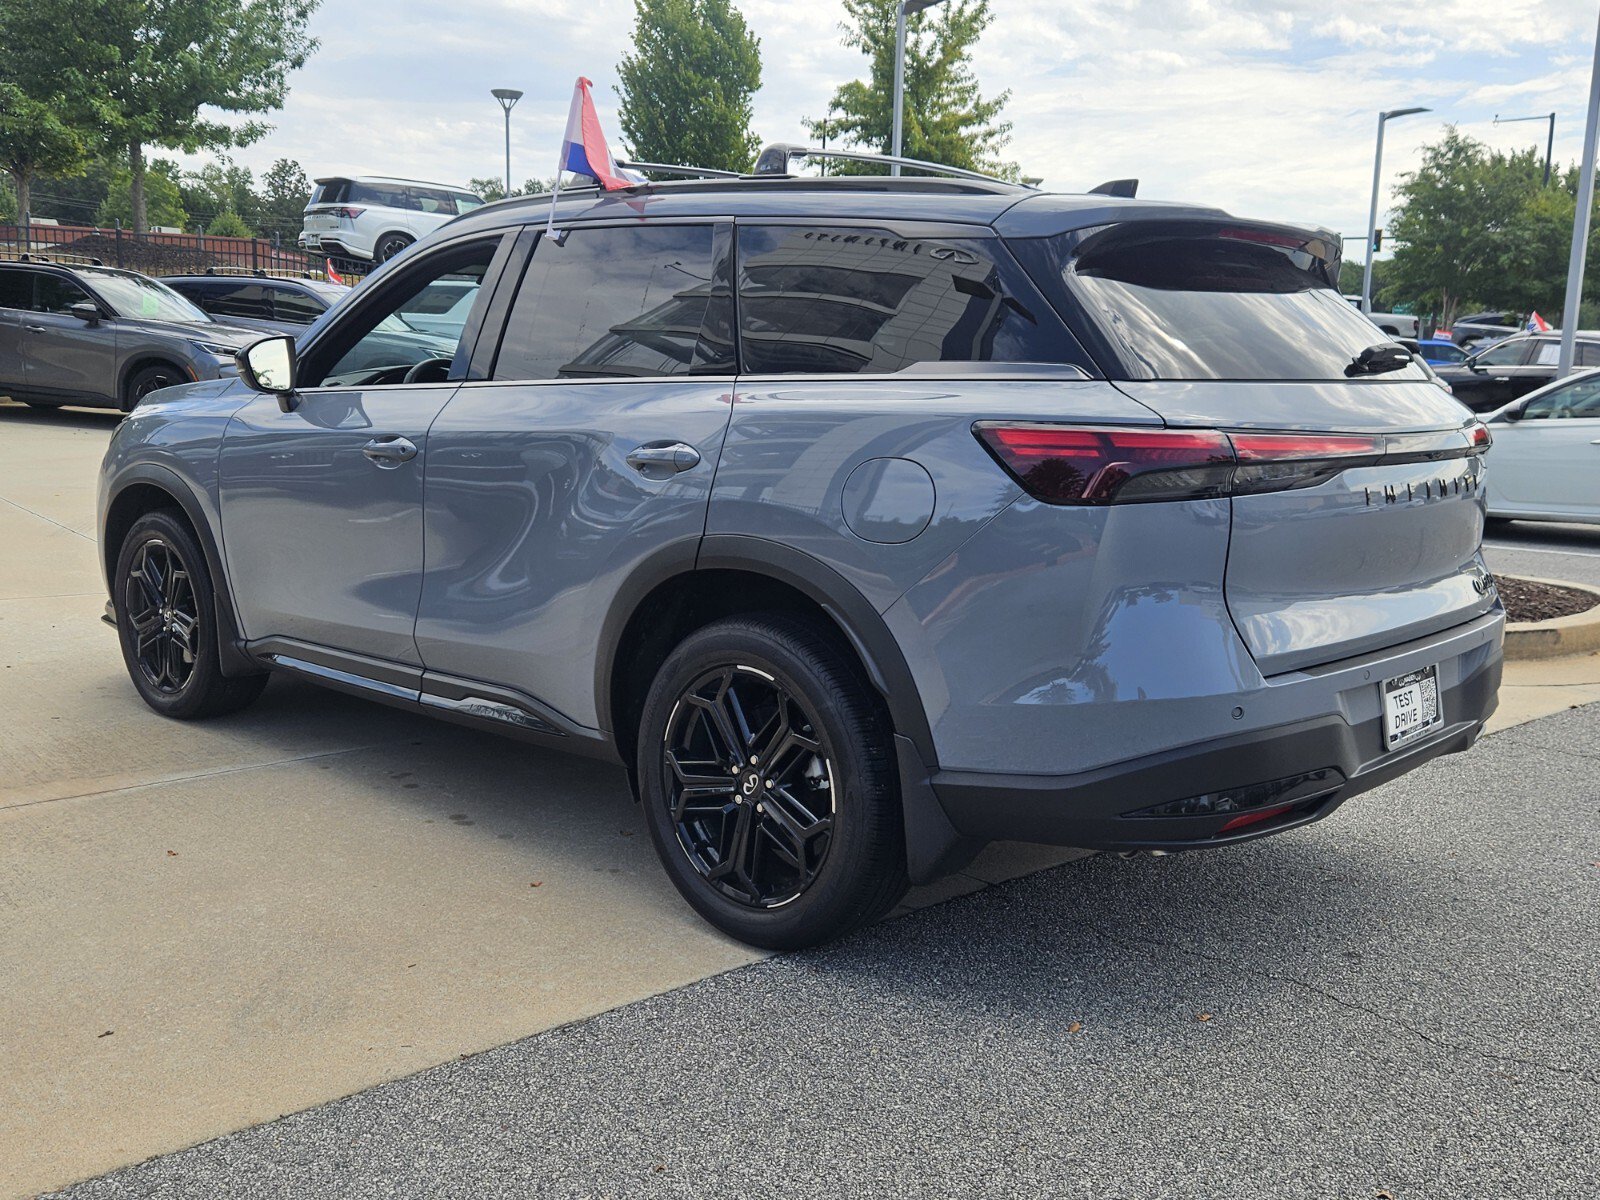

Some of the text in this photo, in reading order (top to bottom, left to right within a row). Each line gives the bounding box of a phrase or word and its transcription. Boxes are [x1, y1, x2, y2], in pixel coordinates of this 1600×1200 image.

[1364, 474, 1478, 506] INFINITI
[1393, 691, 1413, 709] TEST
[1395, 708, 1418, 729] DRIVE
